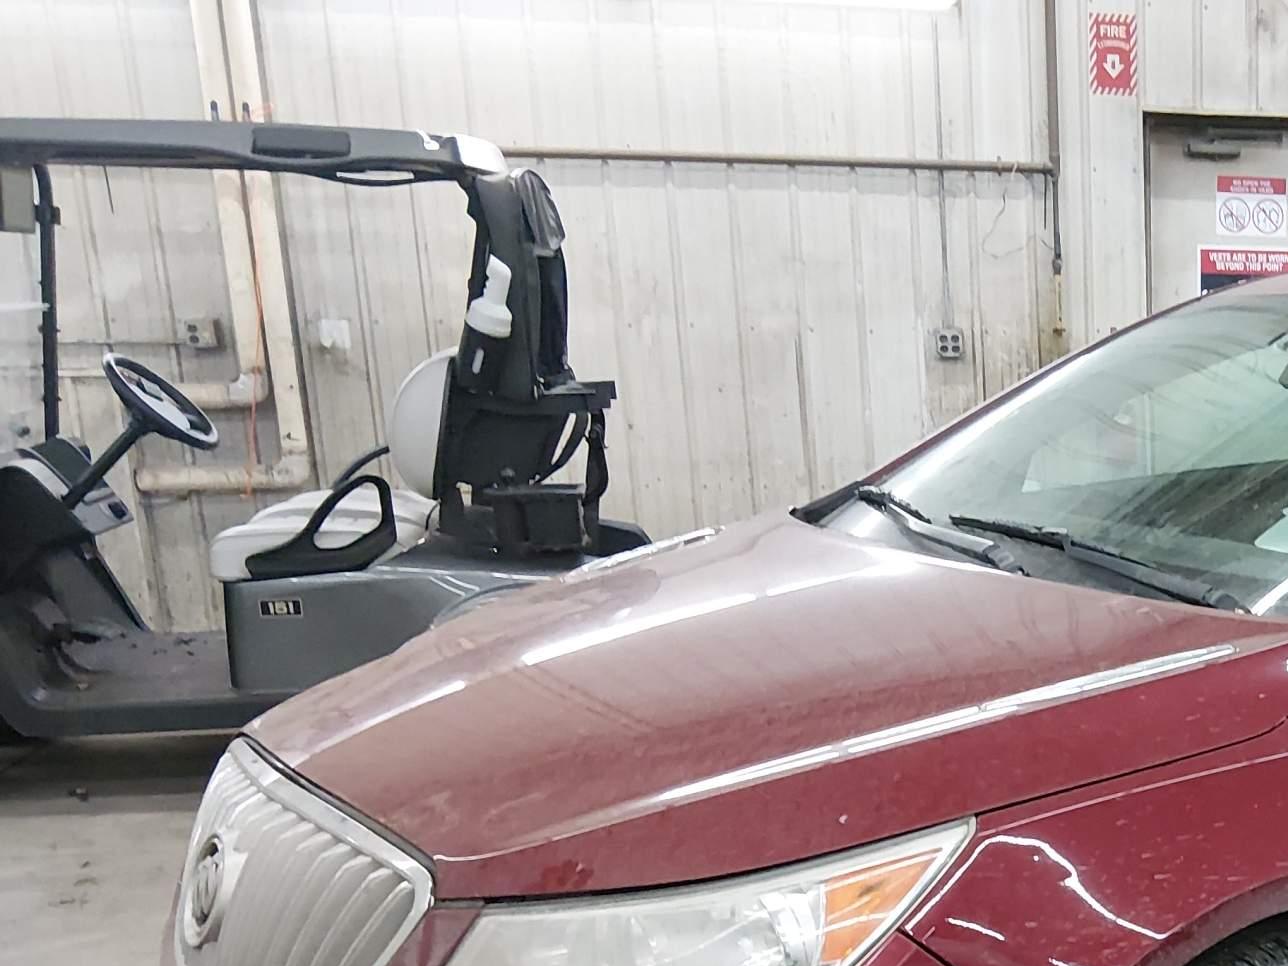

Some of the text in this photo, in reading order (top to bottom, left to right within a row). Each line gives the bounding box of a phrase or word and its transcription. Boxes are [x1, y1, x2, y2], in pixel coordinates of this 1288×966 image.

[1099, 24, 1127, 38] FIRE
[1208, 252, 1231, 262] VESTS
[1232, 252, 1246, 262] ARE
[1247, 253, 1257, 263] TO
[1258, 253, 1267, 263] BE
[1215, 261, 1284, 272] BEYOND THIS POINT
